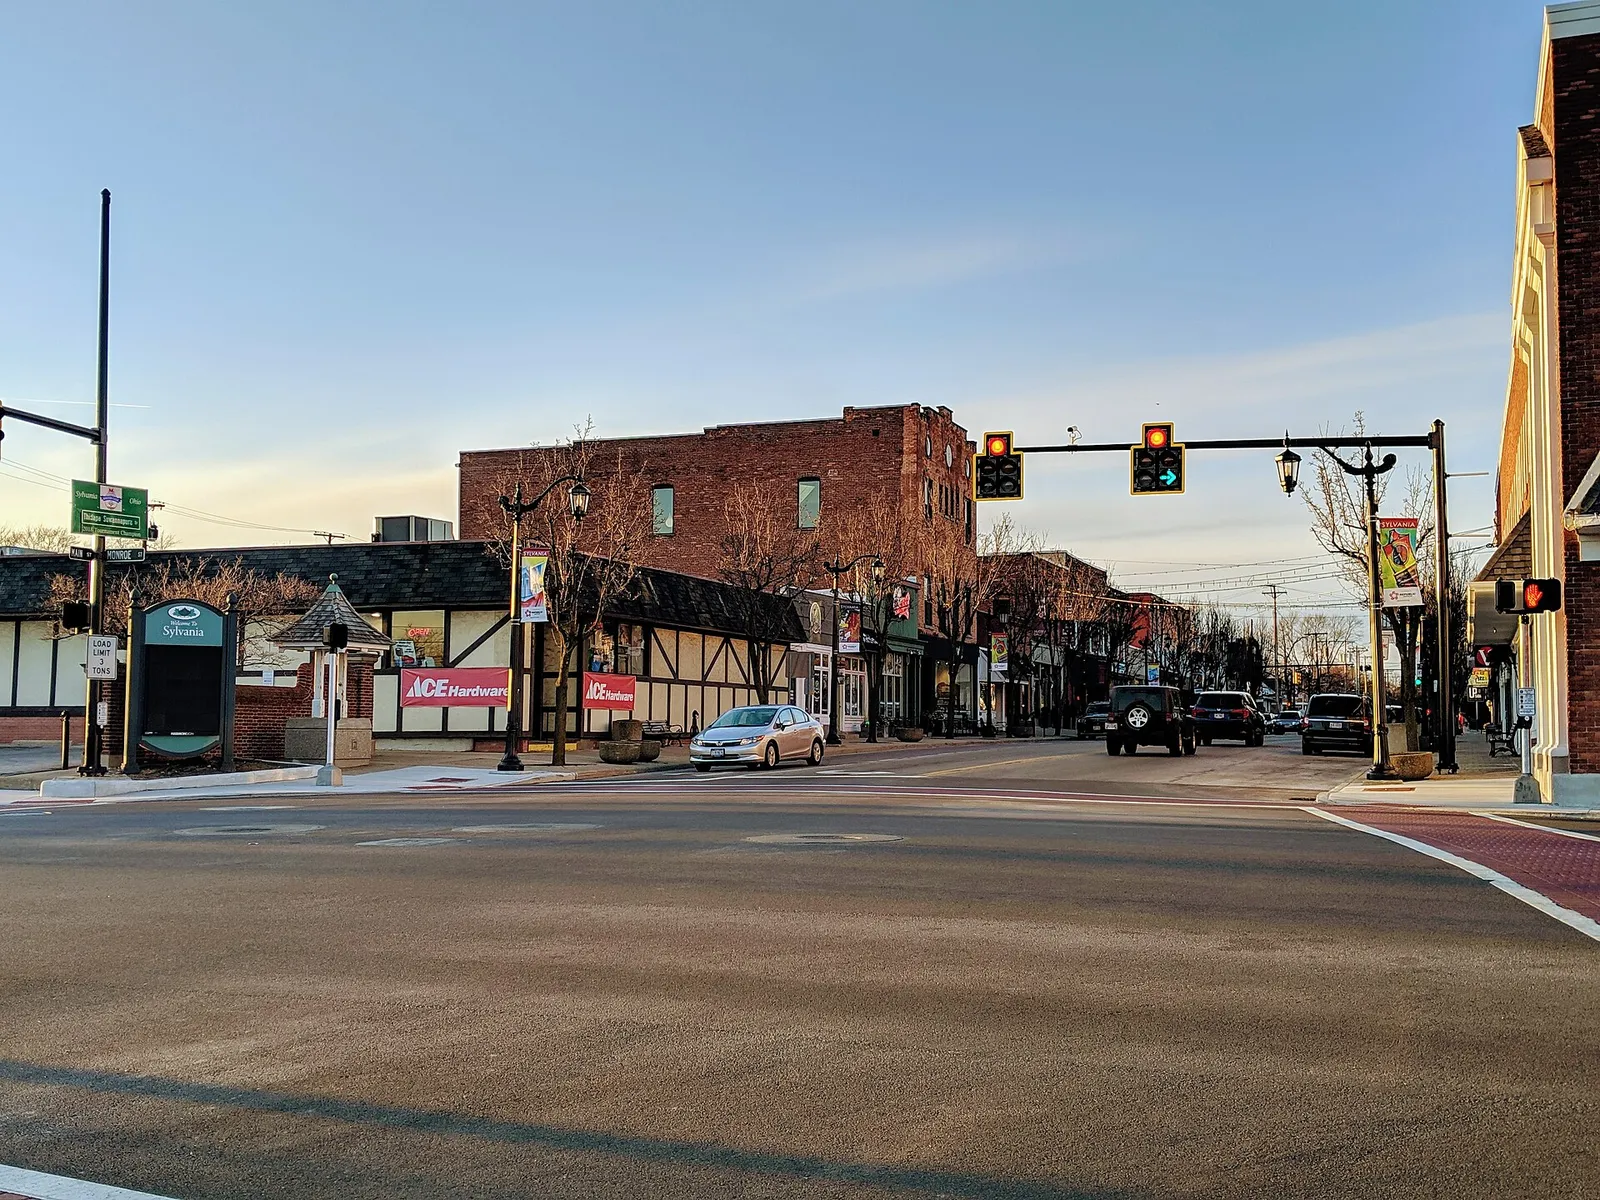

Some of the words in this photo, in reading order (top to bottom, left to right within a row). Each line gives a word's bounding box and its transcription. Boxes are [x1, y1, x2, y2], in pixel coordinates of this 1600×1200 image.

[75, 490, 98, 500] Sylvania
[129, 497, 142, 505] Ohio
[71, 548, 84, 558] MAIN
[107, 550, 132, 560] MONROE
[163, 625, 204, 638] Sylvania
[408, 628, 430, 637] OPEN
[406, 676, 449, 697] ACE
[448, 685, 508, 697] Hardware
[586, 680, 607, 700] ACE
[605, 690, 633, 702] Hardware
